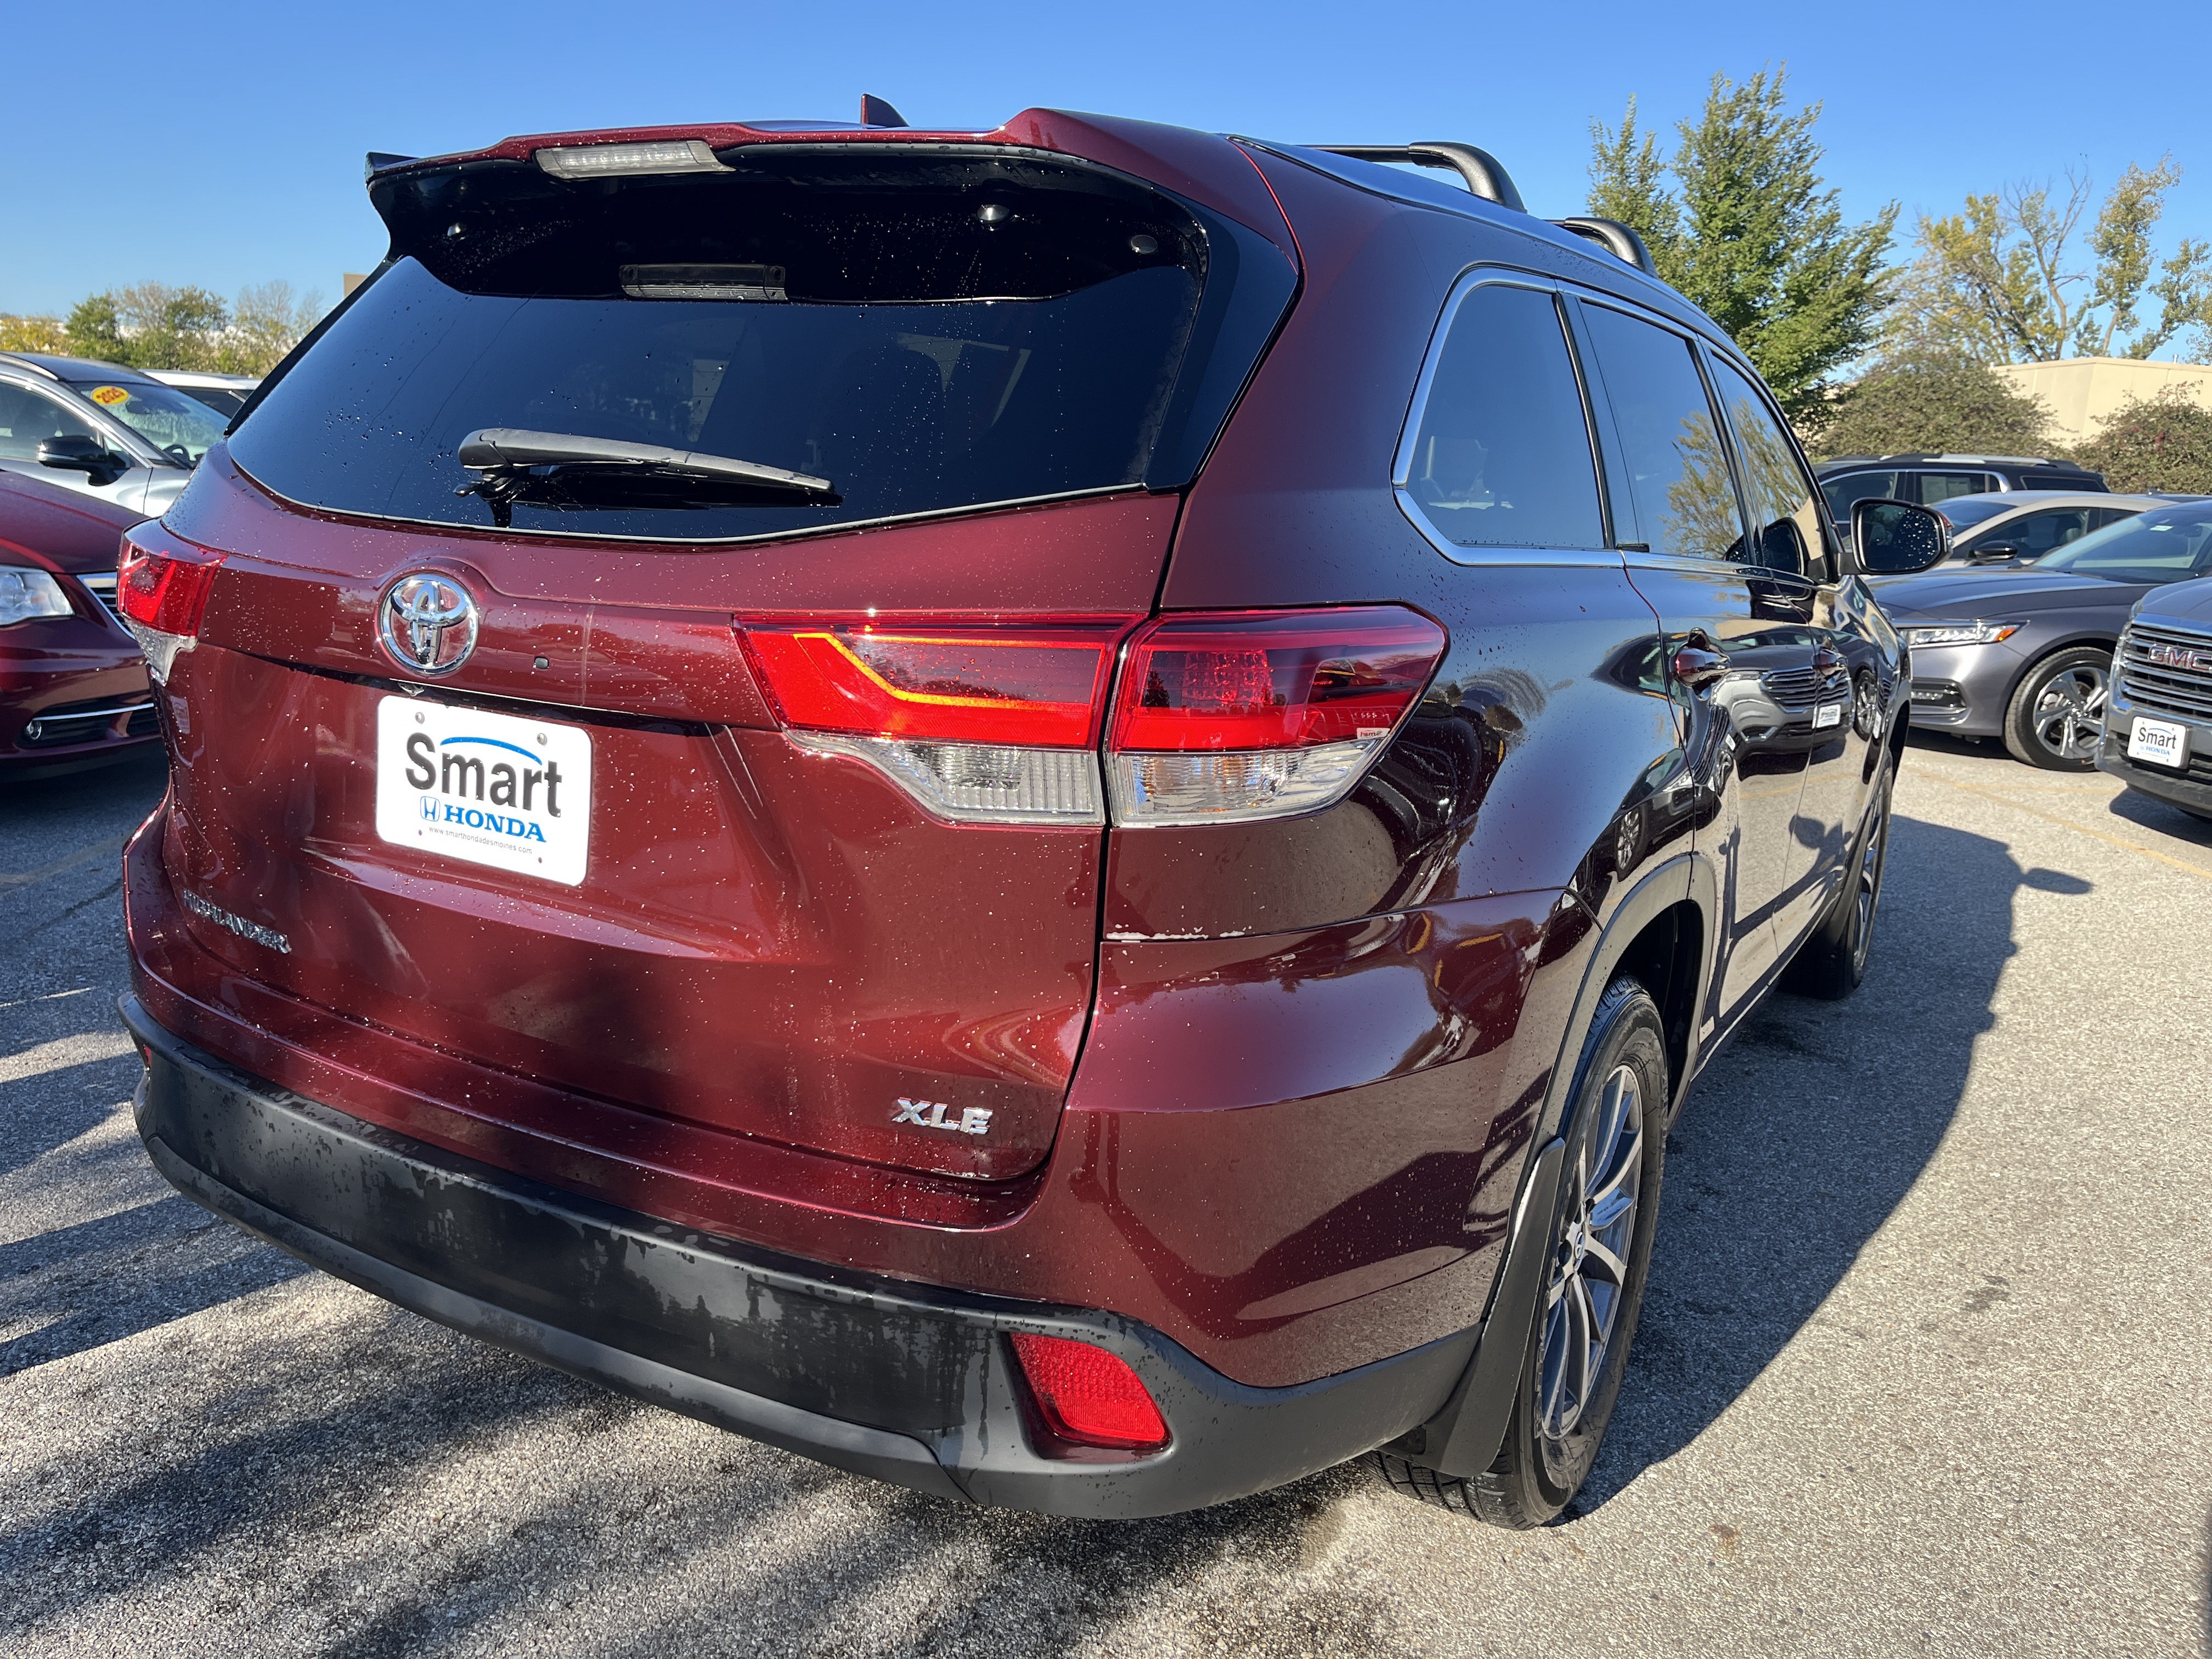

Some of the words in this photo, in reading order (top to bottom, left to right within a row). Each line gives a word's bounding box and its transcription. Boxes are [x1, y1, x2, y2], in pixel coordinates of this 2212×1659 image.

[2148, 644, 2211, 673] GMC
[2138, 727, 2177, 749] Smart
[2146, 746, 2170, 755] HONDA
[405, 732, 562, 818] Smart
[444, 804, 547, 843] HONDA
[891, 1097, 994, 1135] XLE
